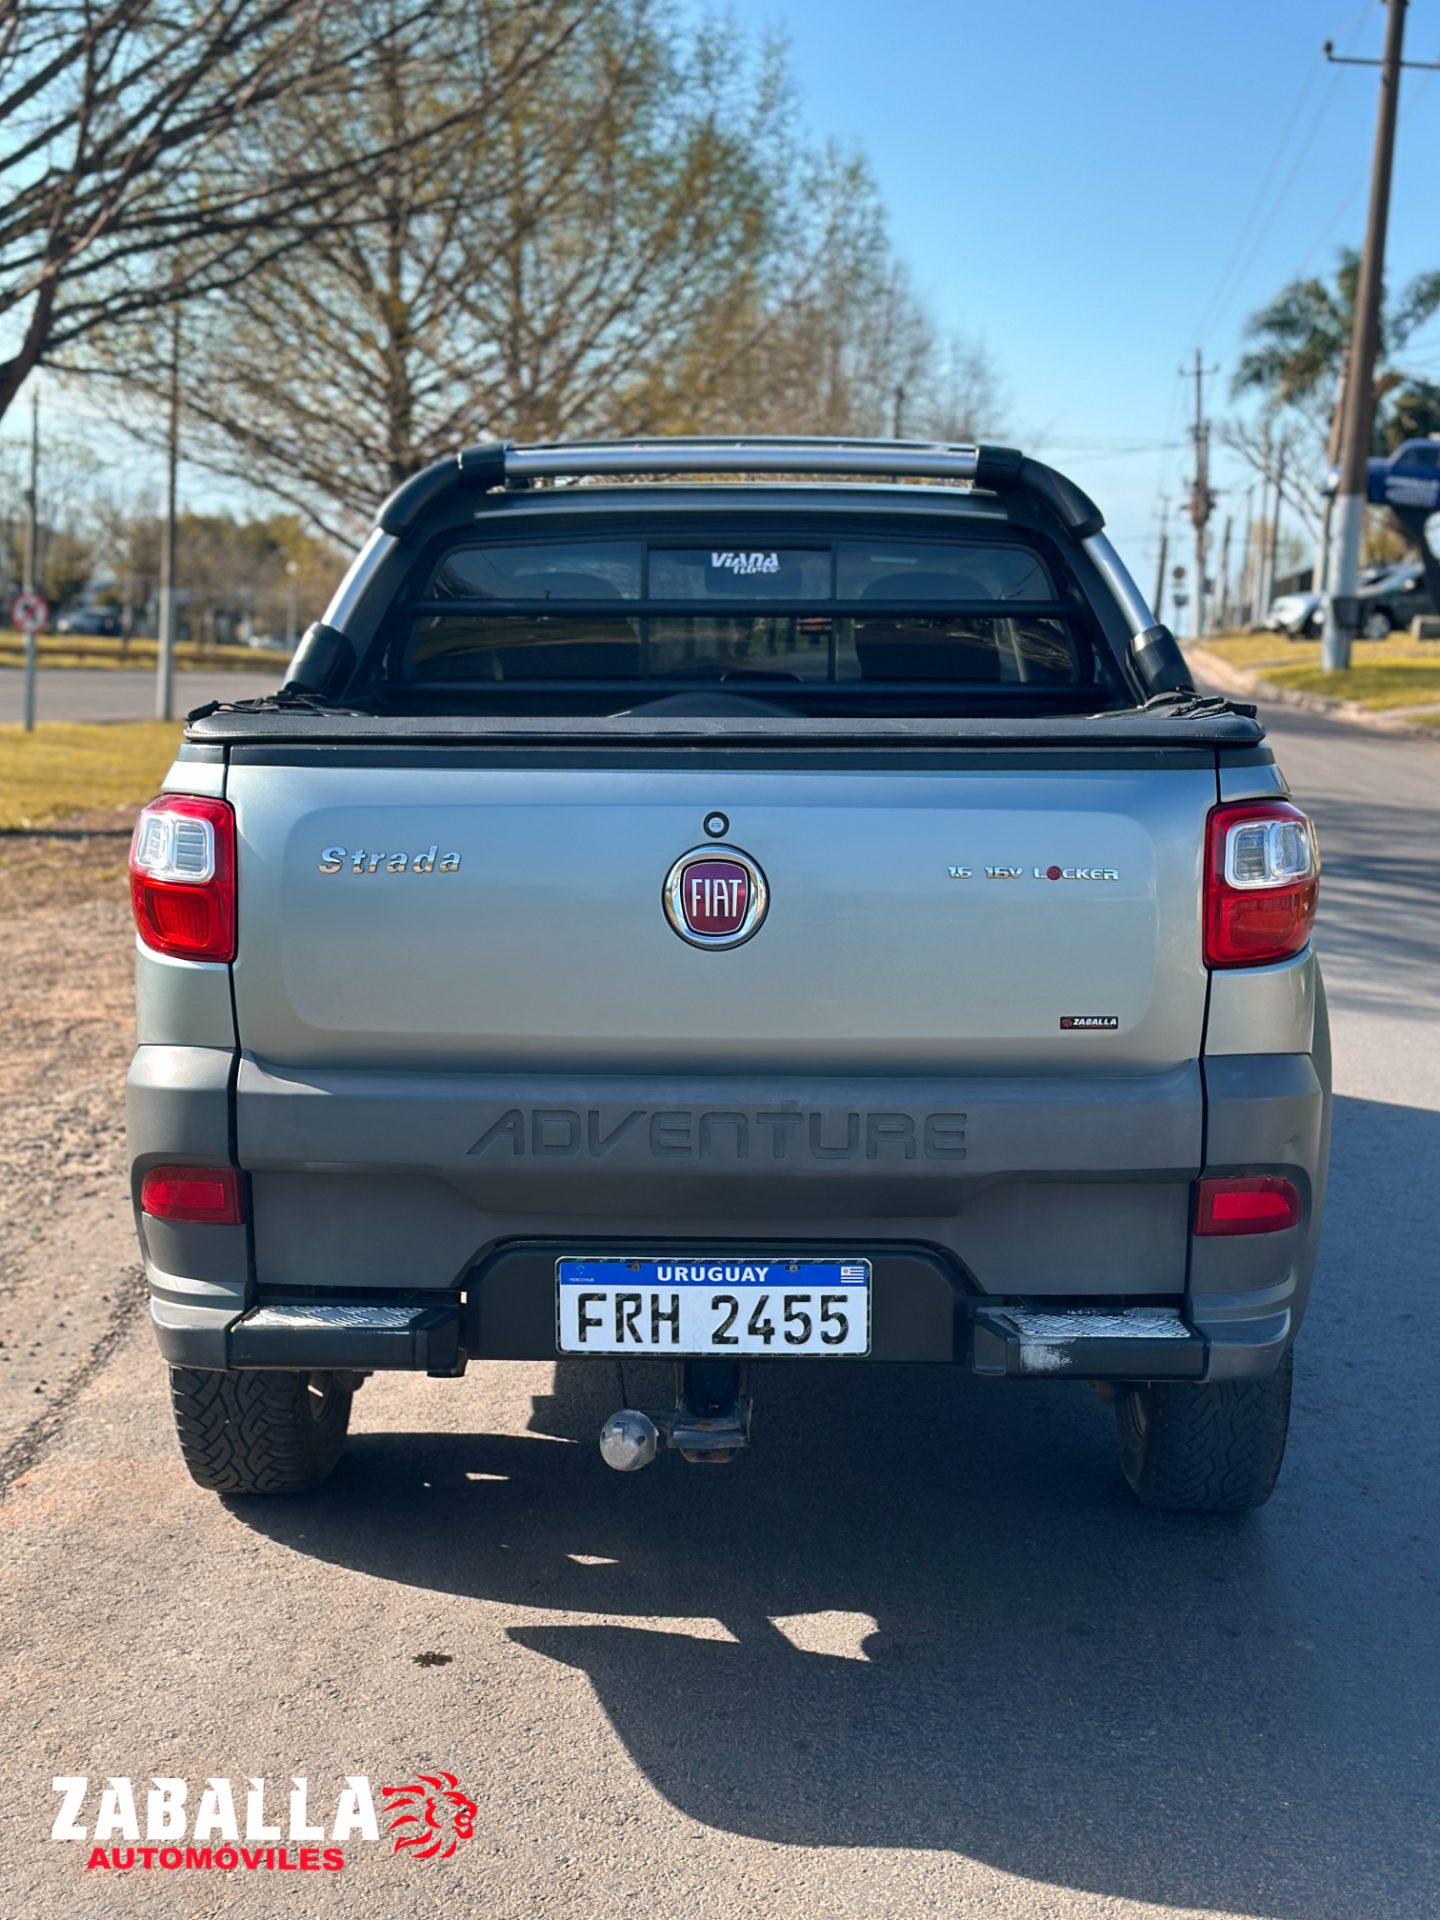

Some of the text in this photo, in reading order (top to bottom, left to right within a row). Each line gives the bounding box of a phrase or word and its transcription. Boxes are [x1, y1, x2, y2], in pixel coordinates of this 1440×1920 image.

[318, 845, 461, 874] Strada
[1032, 865, 1119, 880] LOCKER
[692, 878, 742, 918] FIAT
[1073, 1018, 1117, 1026] ZABALLA
[466, 1109, 967, 1160] ADVENTURE
[656, 1266, 769, 1282] URUGUAY
[577, 1293, 850, 1346] FRH 2455
